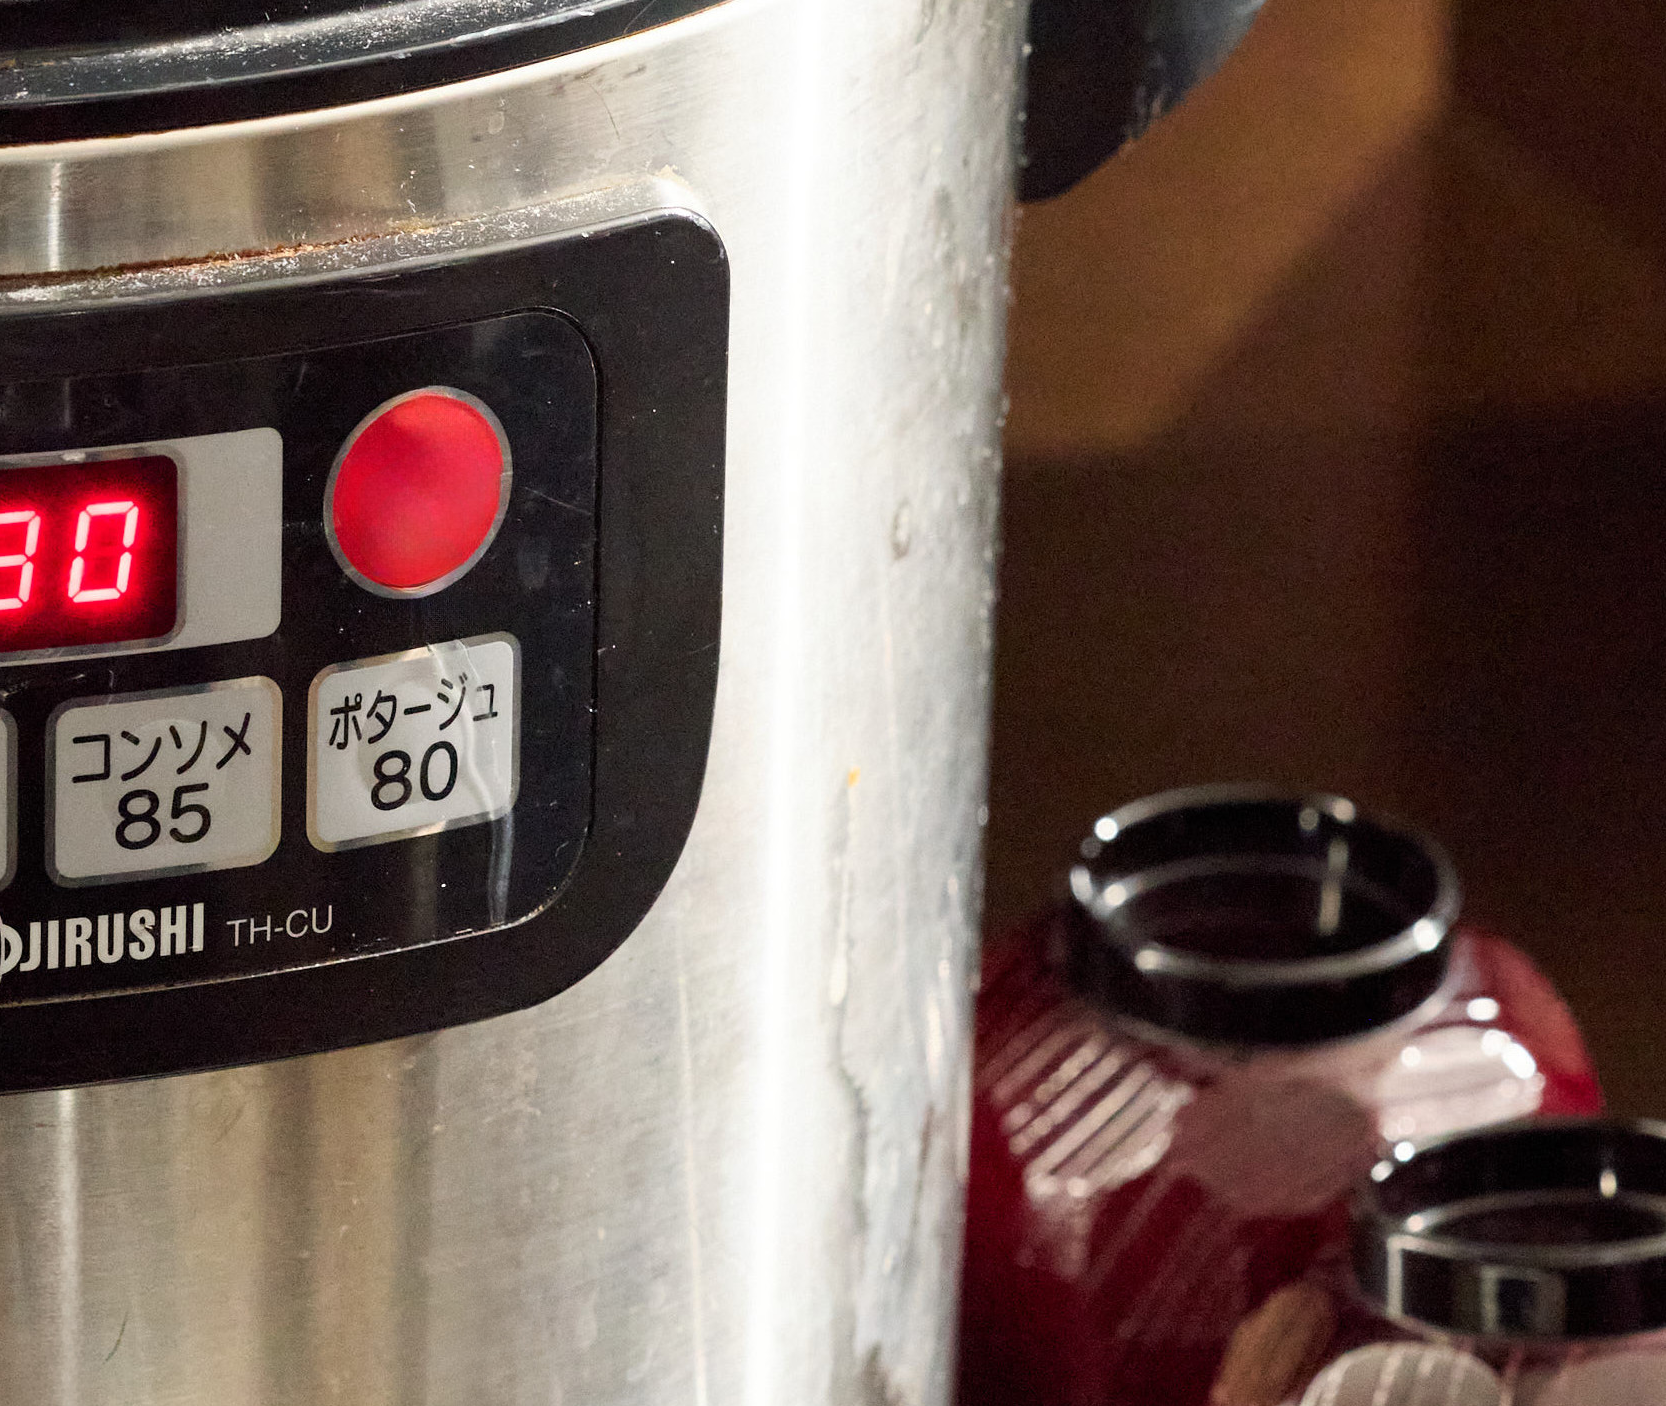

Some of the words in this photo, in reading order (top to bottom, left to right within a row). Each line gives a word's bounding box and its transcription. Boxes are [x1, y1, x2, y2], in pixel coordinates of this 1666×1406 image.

[329, 673, 498, 749] ポタージュ
[72, 712, 251, 783] コンソメ
[370, 741, 459, 811] 80
[114, 783, 211, 849] 85
[226, 905, 333, 947] TH-CU
